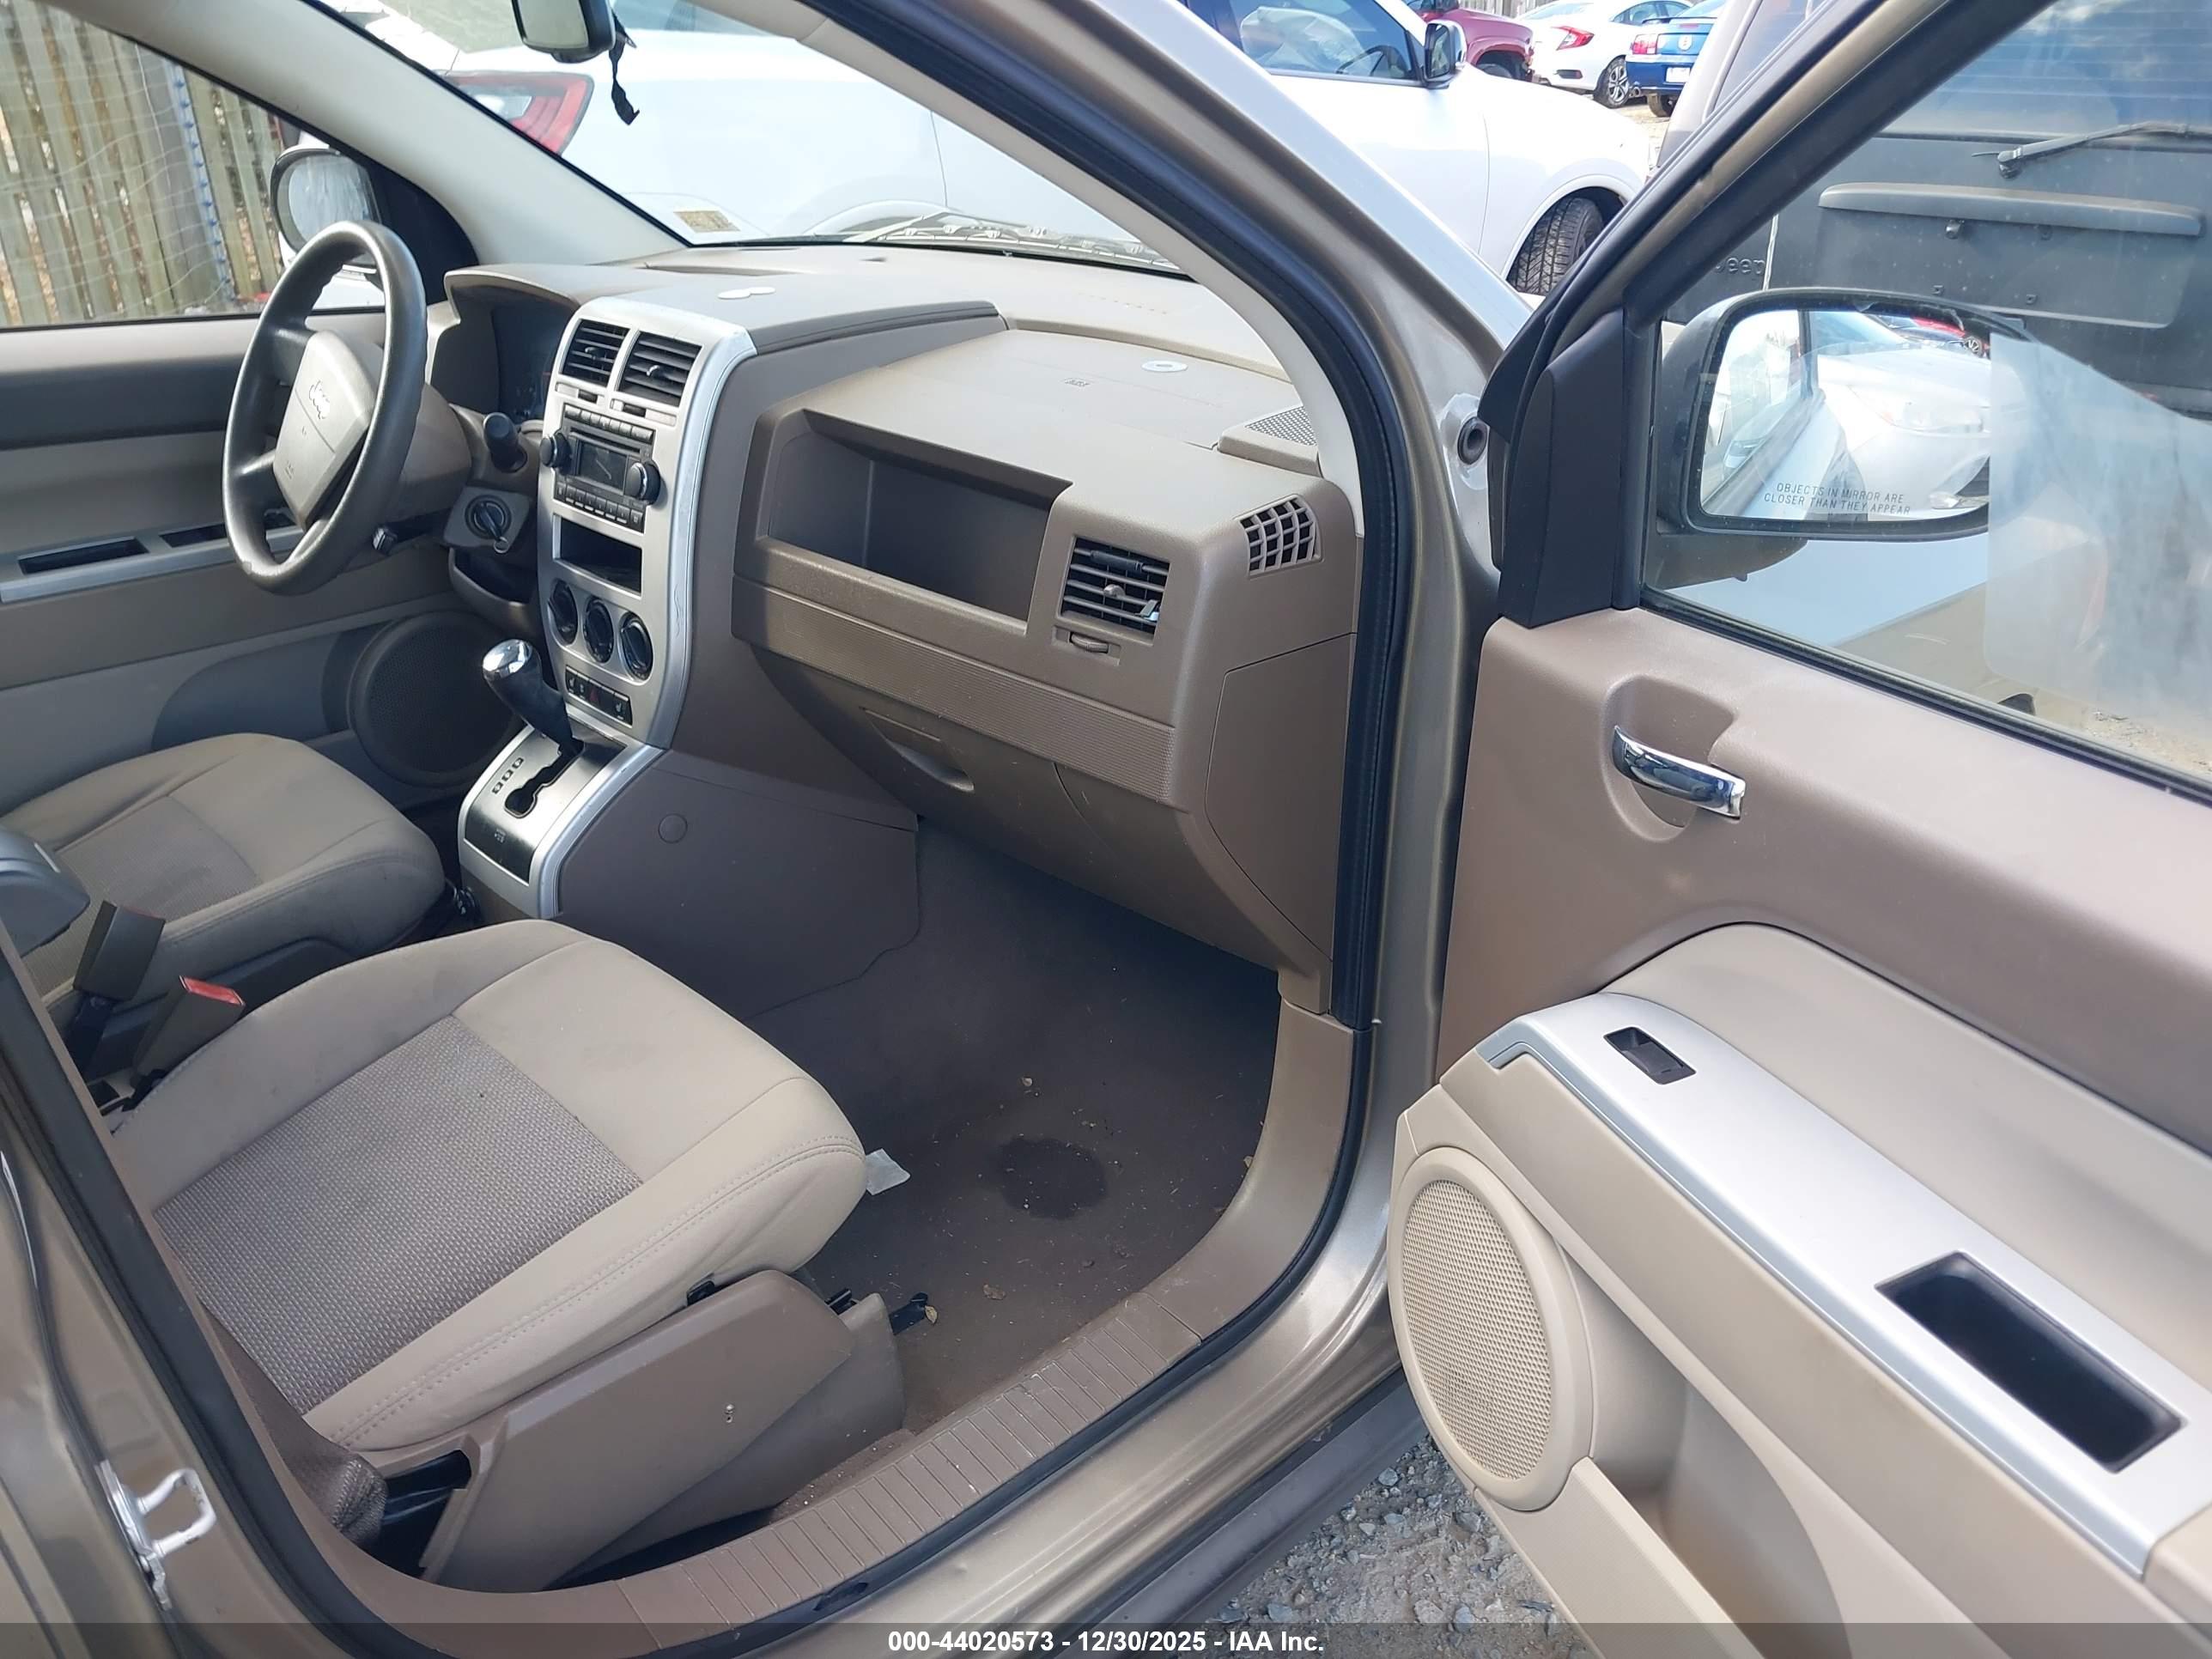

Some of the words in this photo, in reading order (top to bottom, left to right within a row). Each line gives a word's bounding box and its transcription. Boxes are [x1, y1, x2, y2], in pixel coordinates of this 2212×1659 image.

[1777, 483, 1825, 496] OBJECTS
[1827, 487, 1838, 497] IN
[1841, 489, 1880, 501] MIRROR
[1884, 493, 1904, 503] ARE
[1764, 493, 1804, 506] CLOSER
[1810, 498, 1837, 509] THAN
[1841, 500, 1868, 511] THEY
[1869, 504, 1911, 514] APPEAR
